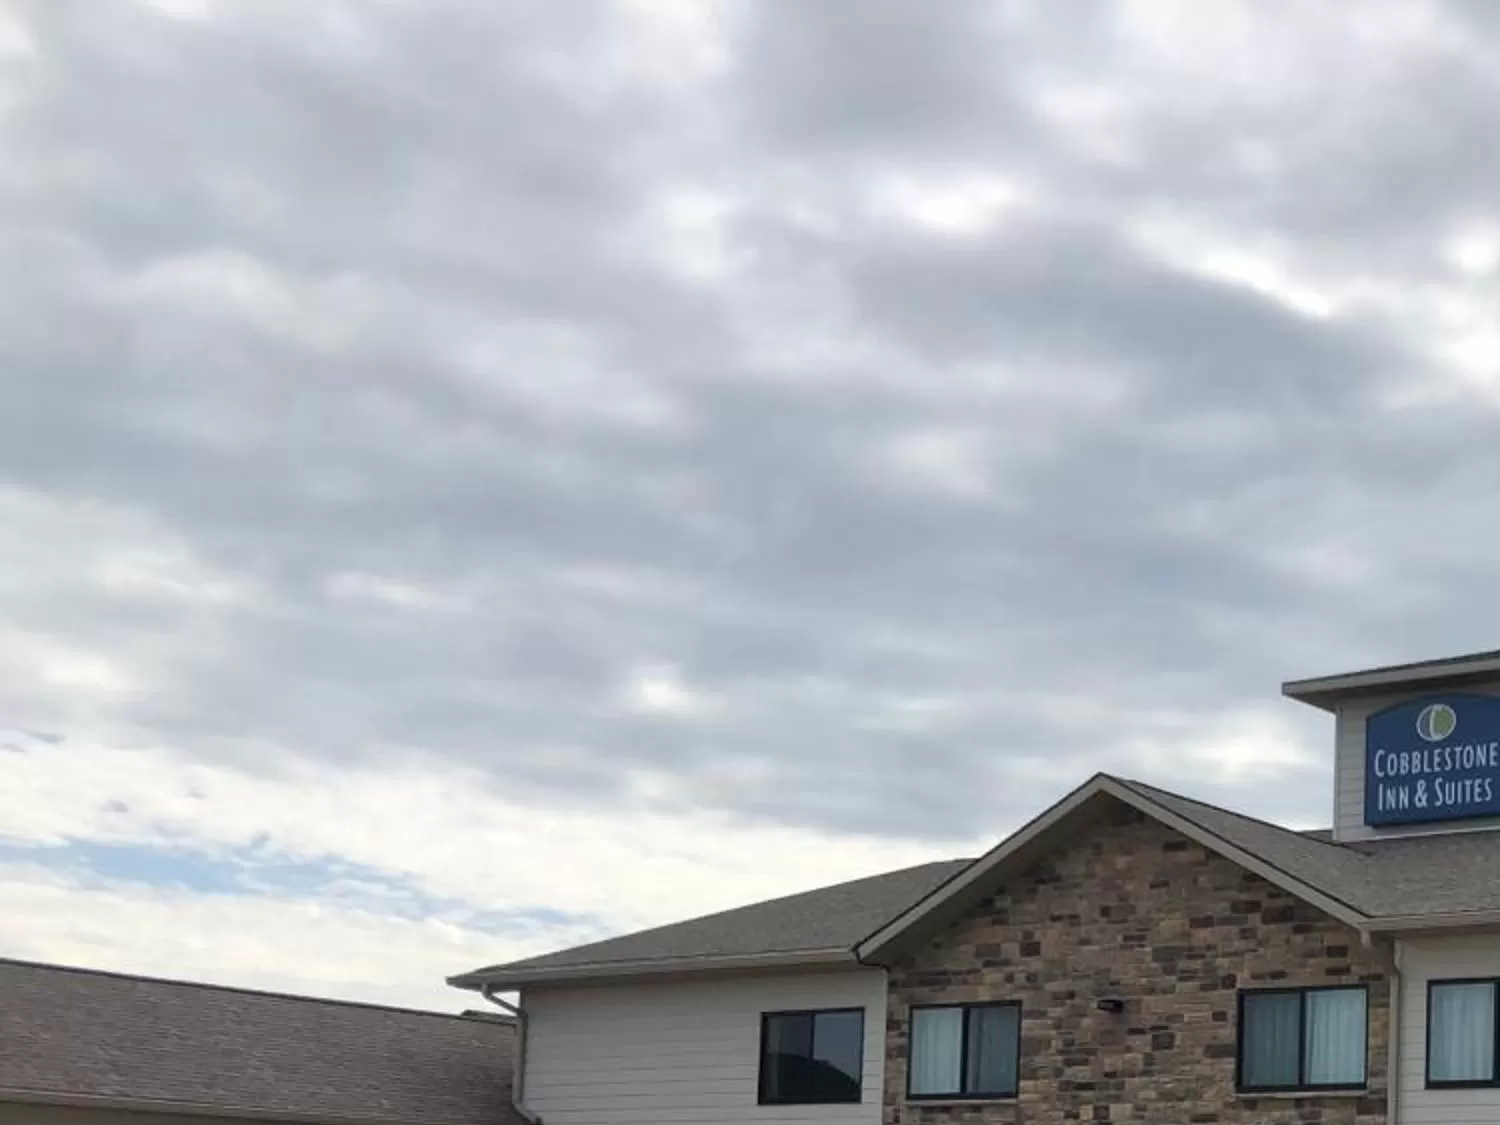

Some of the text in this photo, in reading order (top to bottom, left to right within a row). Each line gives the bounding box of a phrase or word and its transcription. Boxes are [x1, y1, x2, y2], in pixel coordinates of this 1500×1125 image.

[1374, 742, 1499, 777] COBBLESTONE
[1378, 777, 1493, 811] INN & SUITES
